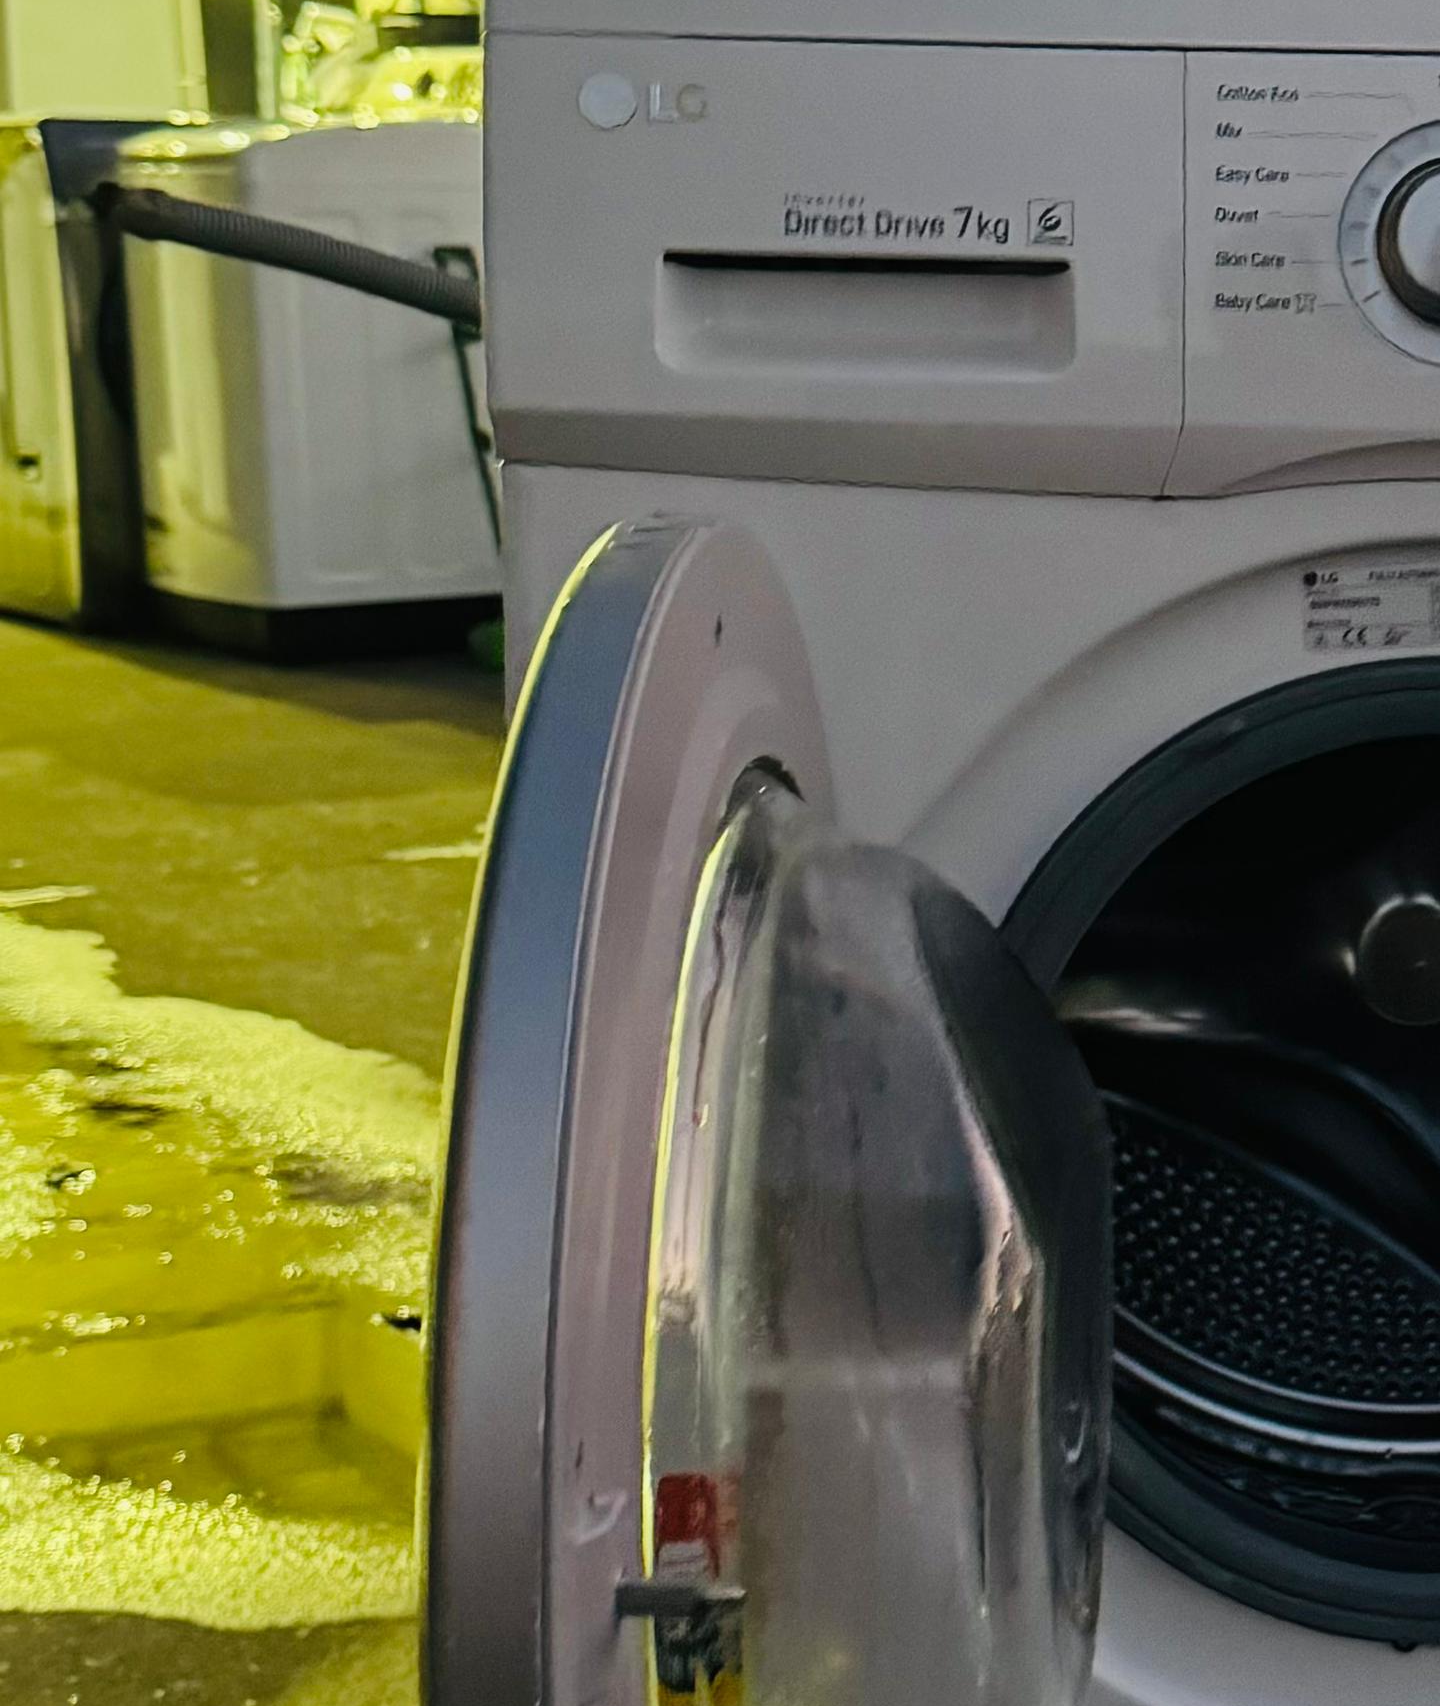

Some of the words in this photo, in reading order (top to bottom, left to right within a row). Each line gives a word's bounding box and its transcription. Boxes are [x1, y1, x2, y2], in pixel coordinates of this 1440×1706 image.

[647, 81, 706, 124] LG
[1216, 165, 1251, 185] Easy
[1255, 167, 1289, 182] Care
[784, 208, 865, 237] Direct
[875, 208, 945, 238] Drive
[953, 205, 973, 238] 7
[977, 209, 1010, 244] kg
[1251, 253, 1285, 268] Care
[1215, 293, 1253, 313] Baby
